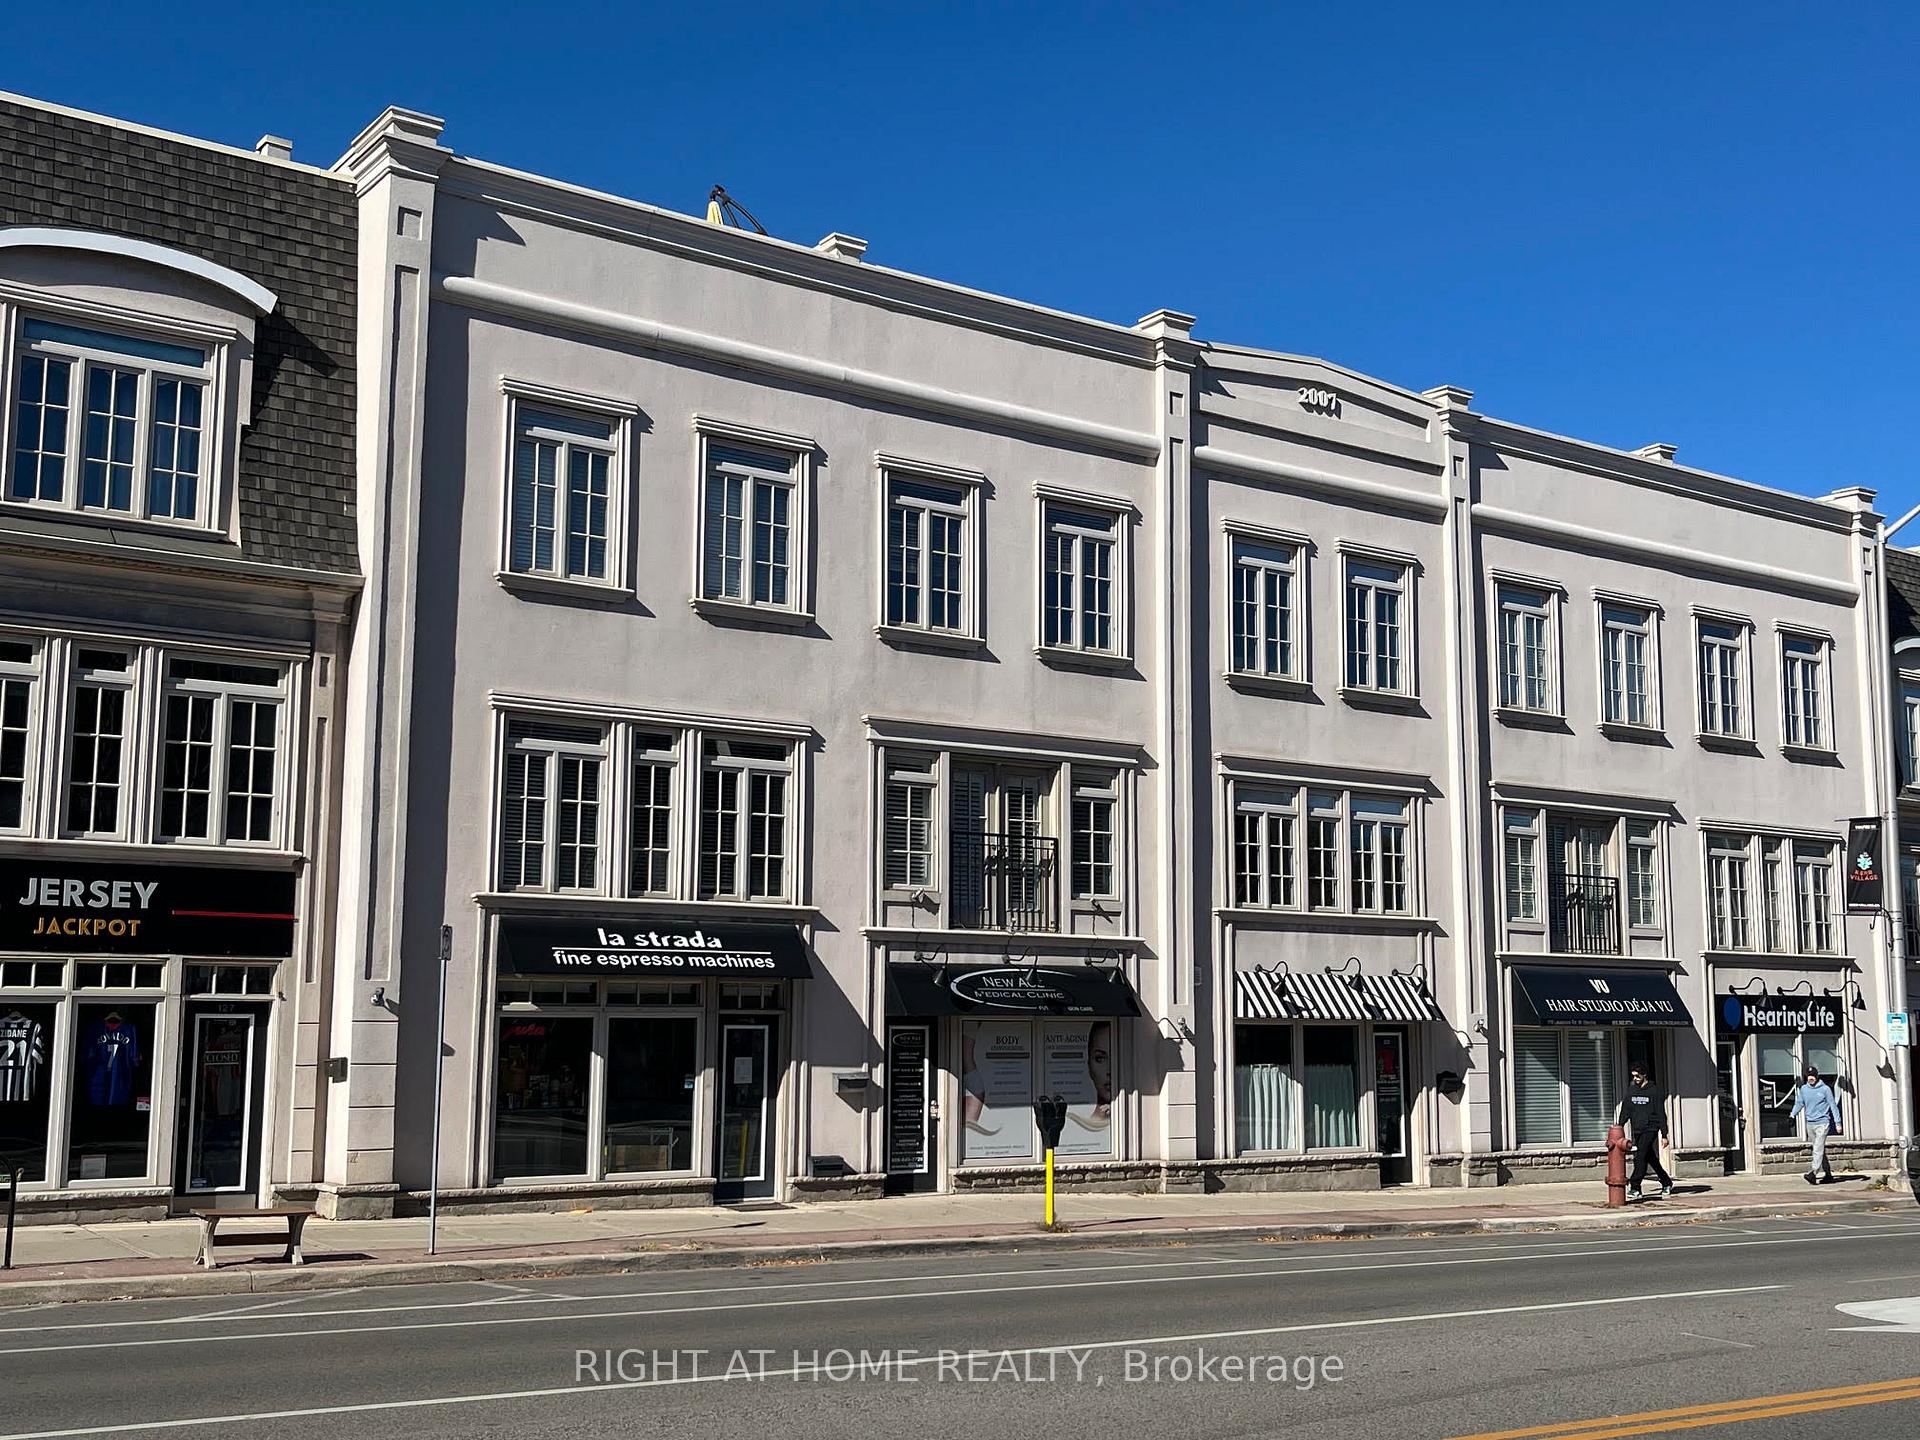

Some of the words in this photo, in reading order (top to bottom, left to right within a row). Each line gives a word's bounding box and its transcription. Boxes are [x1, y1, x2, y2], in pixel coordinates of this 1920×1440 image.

[1298, 387, 1337, 410] 2007
[19, 877, 159, 909] JERSEY
[33, 916, 141, 937] JACKPOT
[597, 928, 625, 946] la
[634, 931, 722, 948] strada
[553, 950, 592, 966] fine
[597, 952, 684, 969] espresso
[688, 953, 776, 969] machines
[982, 976, 1017, 988] NEW
[1027, 991, 1065, 999] CLINIC
[1546, 999, 1579, 1012] HAIR
[1578, 999, 1624, 1012] STUDIO
[1655, 1000, 1674, 1012] VU
[1743, 1000, 1834, 1032] HearingLife
[0, 1029, 28, 1038] ZIDANE
[995, 1035, 1021, 1045] BODY
[0, 1039, 27, 1067] 21
